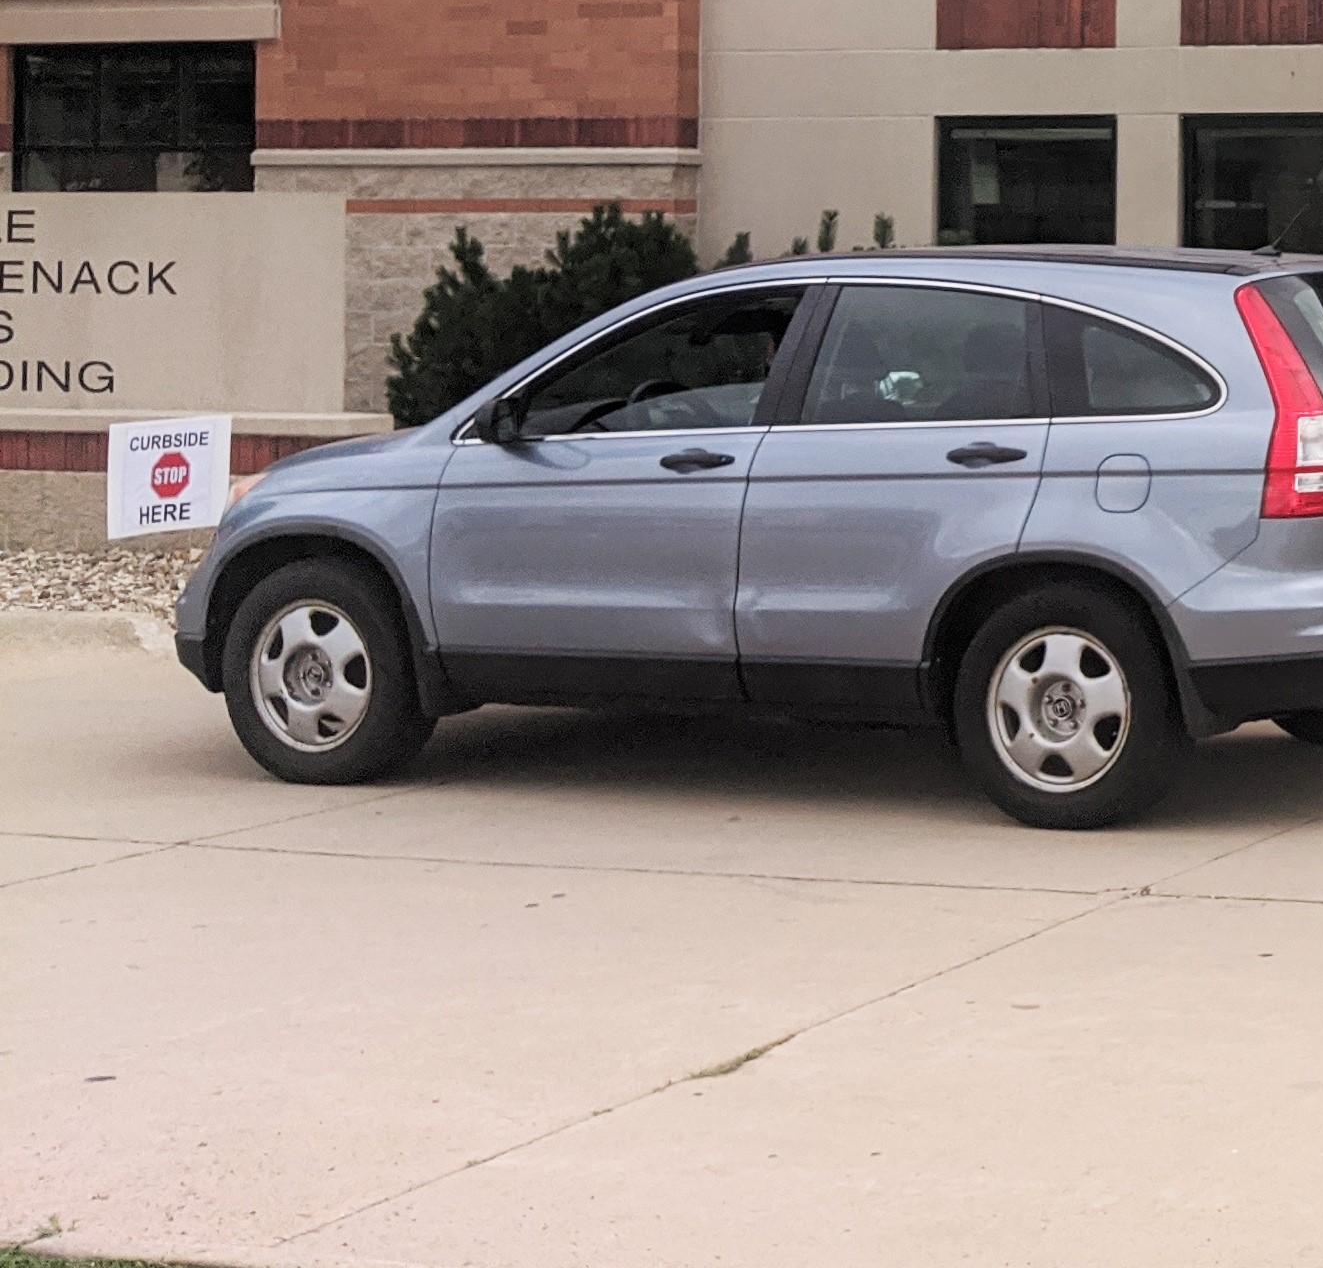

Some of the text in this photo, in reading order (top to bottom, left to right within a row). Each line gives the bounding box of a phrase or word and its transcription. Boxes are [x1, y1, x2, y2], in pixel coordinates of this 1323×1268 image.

[0, 260, 178, 295] ENACK
[129, 431, 209, 452] CURBSIDE
[154, 466, 187, 485] STOP
[139, 502, 191, 525] HERE
